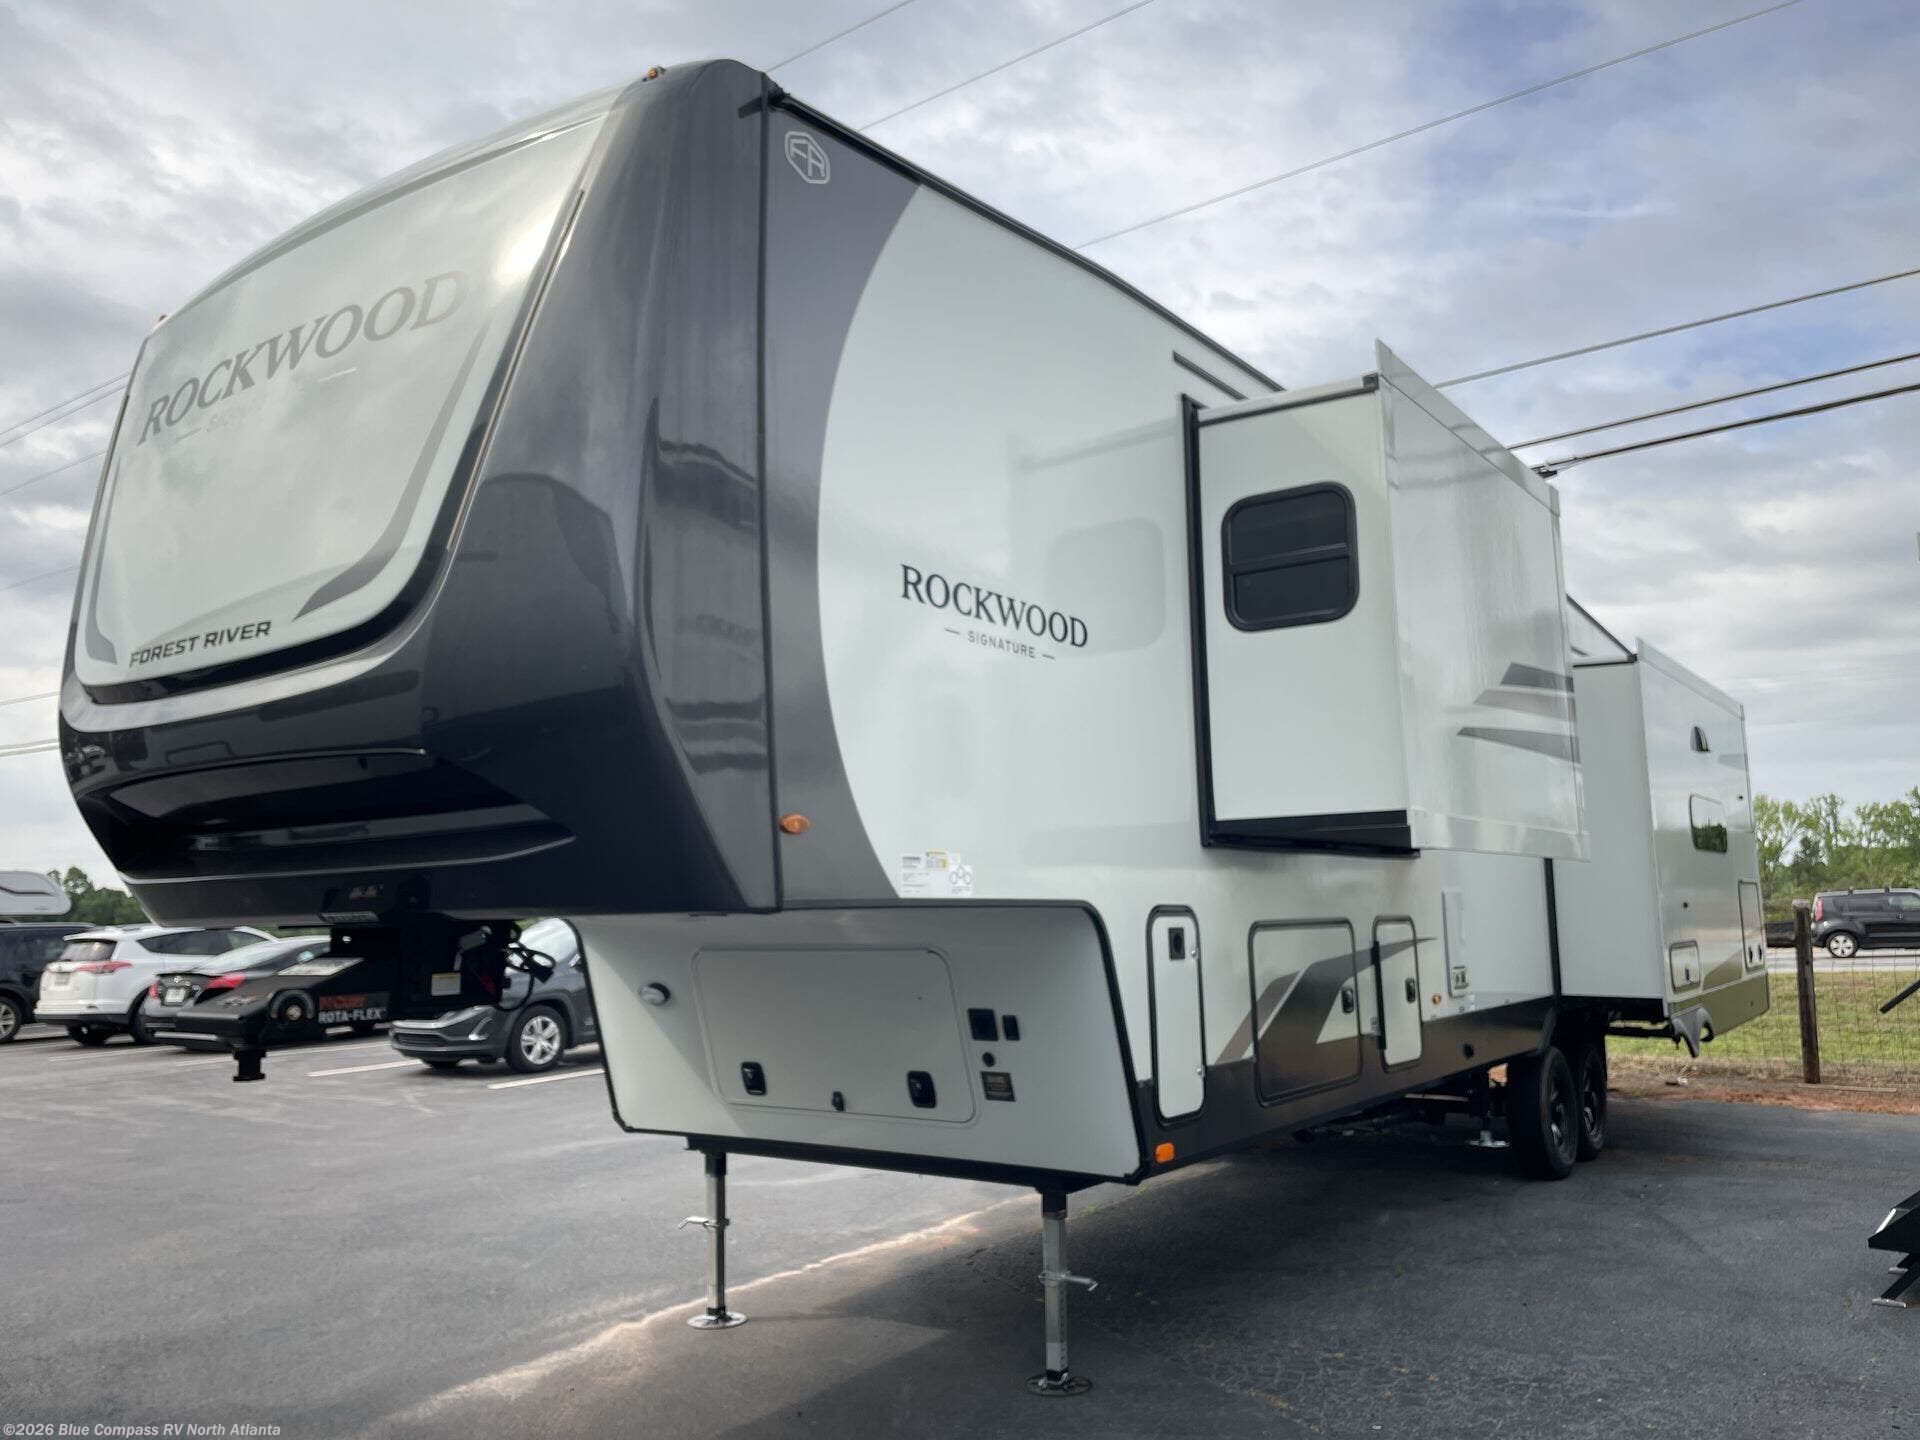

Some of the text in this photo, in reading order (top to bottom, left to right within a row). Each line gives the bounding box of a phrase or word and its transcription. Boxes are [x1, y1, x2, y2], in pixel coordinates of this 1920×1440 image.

[138, 271, 469, 446] ROCKWOOD
[901, 563, 1089, 648] ROCKWOOD
[129, 621, 272, 668] FOREST RIVER
[967, 630, 1037, 659] SIGNATURE
